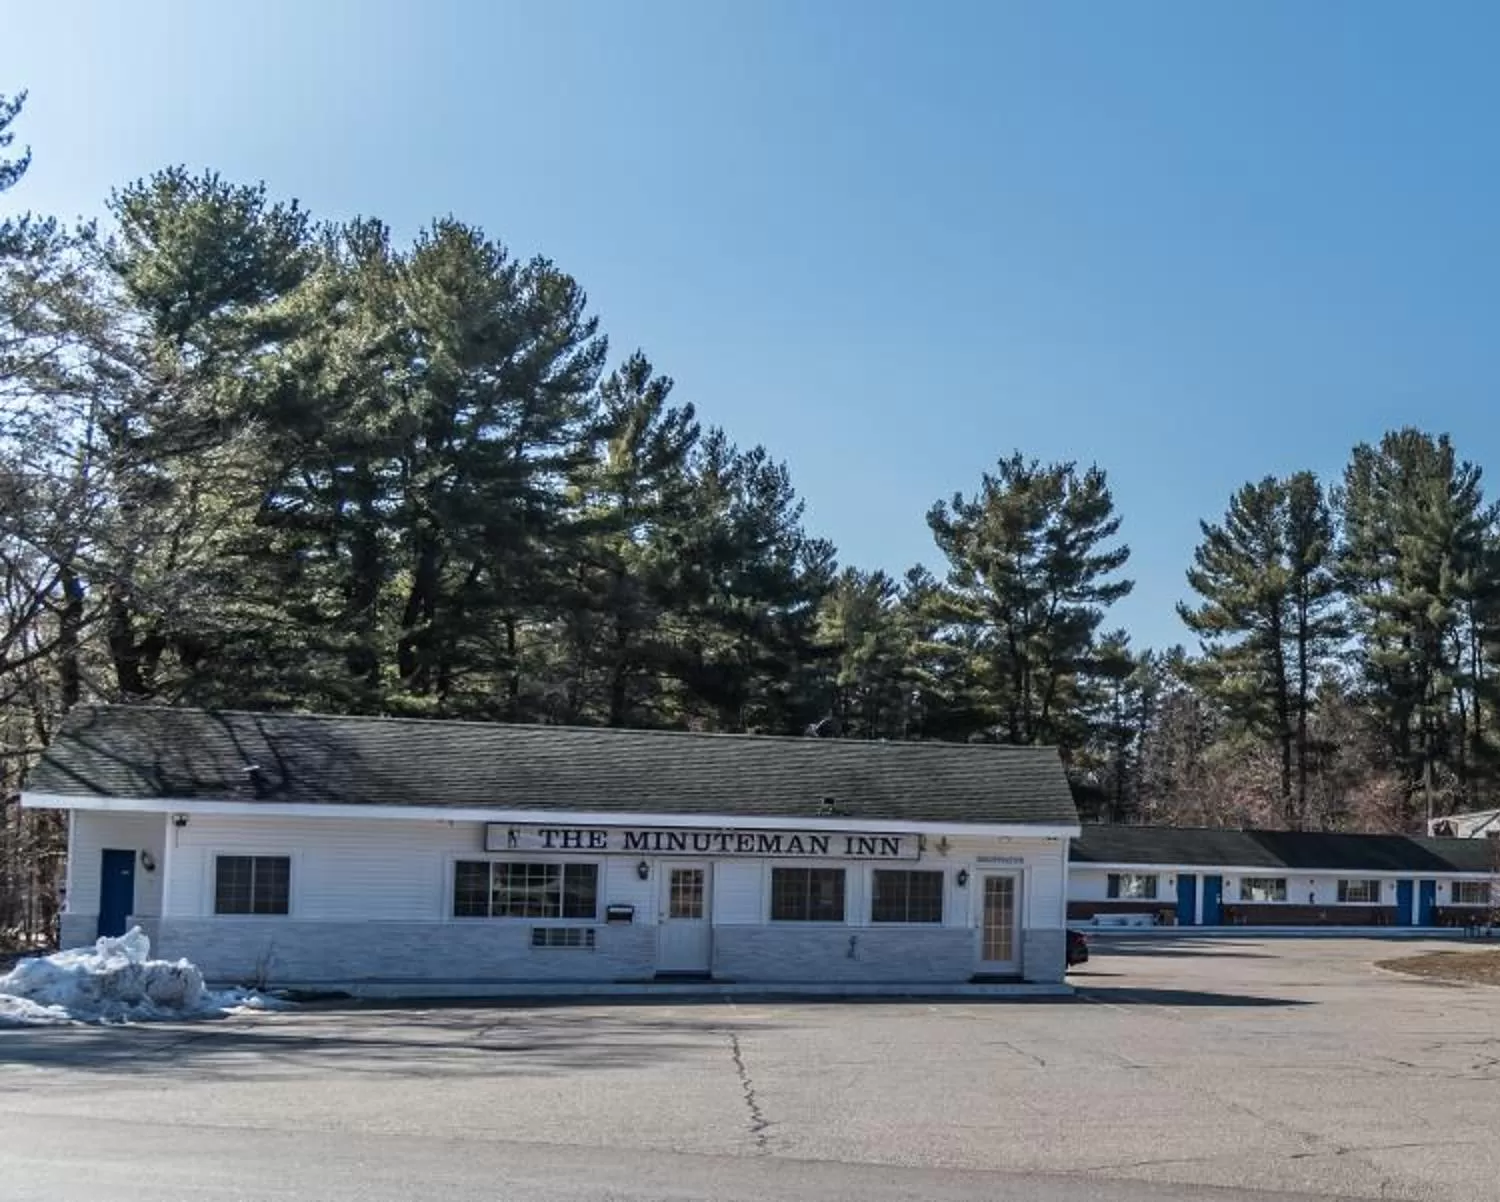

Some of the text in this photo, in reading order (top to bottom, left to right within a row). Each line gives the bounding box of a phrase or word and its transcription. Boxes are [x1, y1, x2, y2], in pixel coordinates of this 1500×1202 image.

[538, 829, 901, 856] THE MINUTEMAN INN
